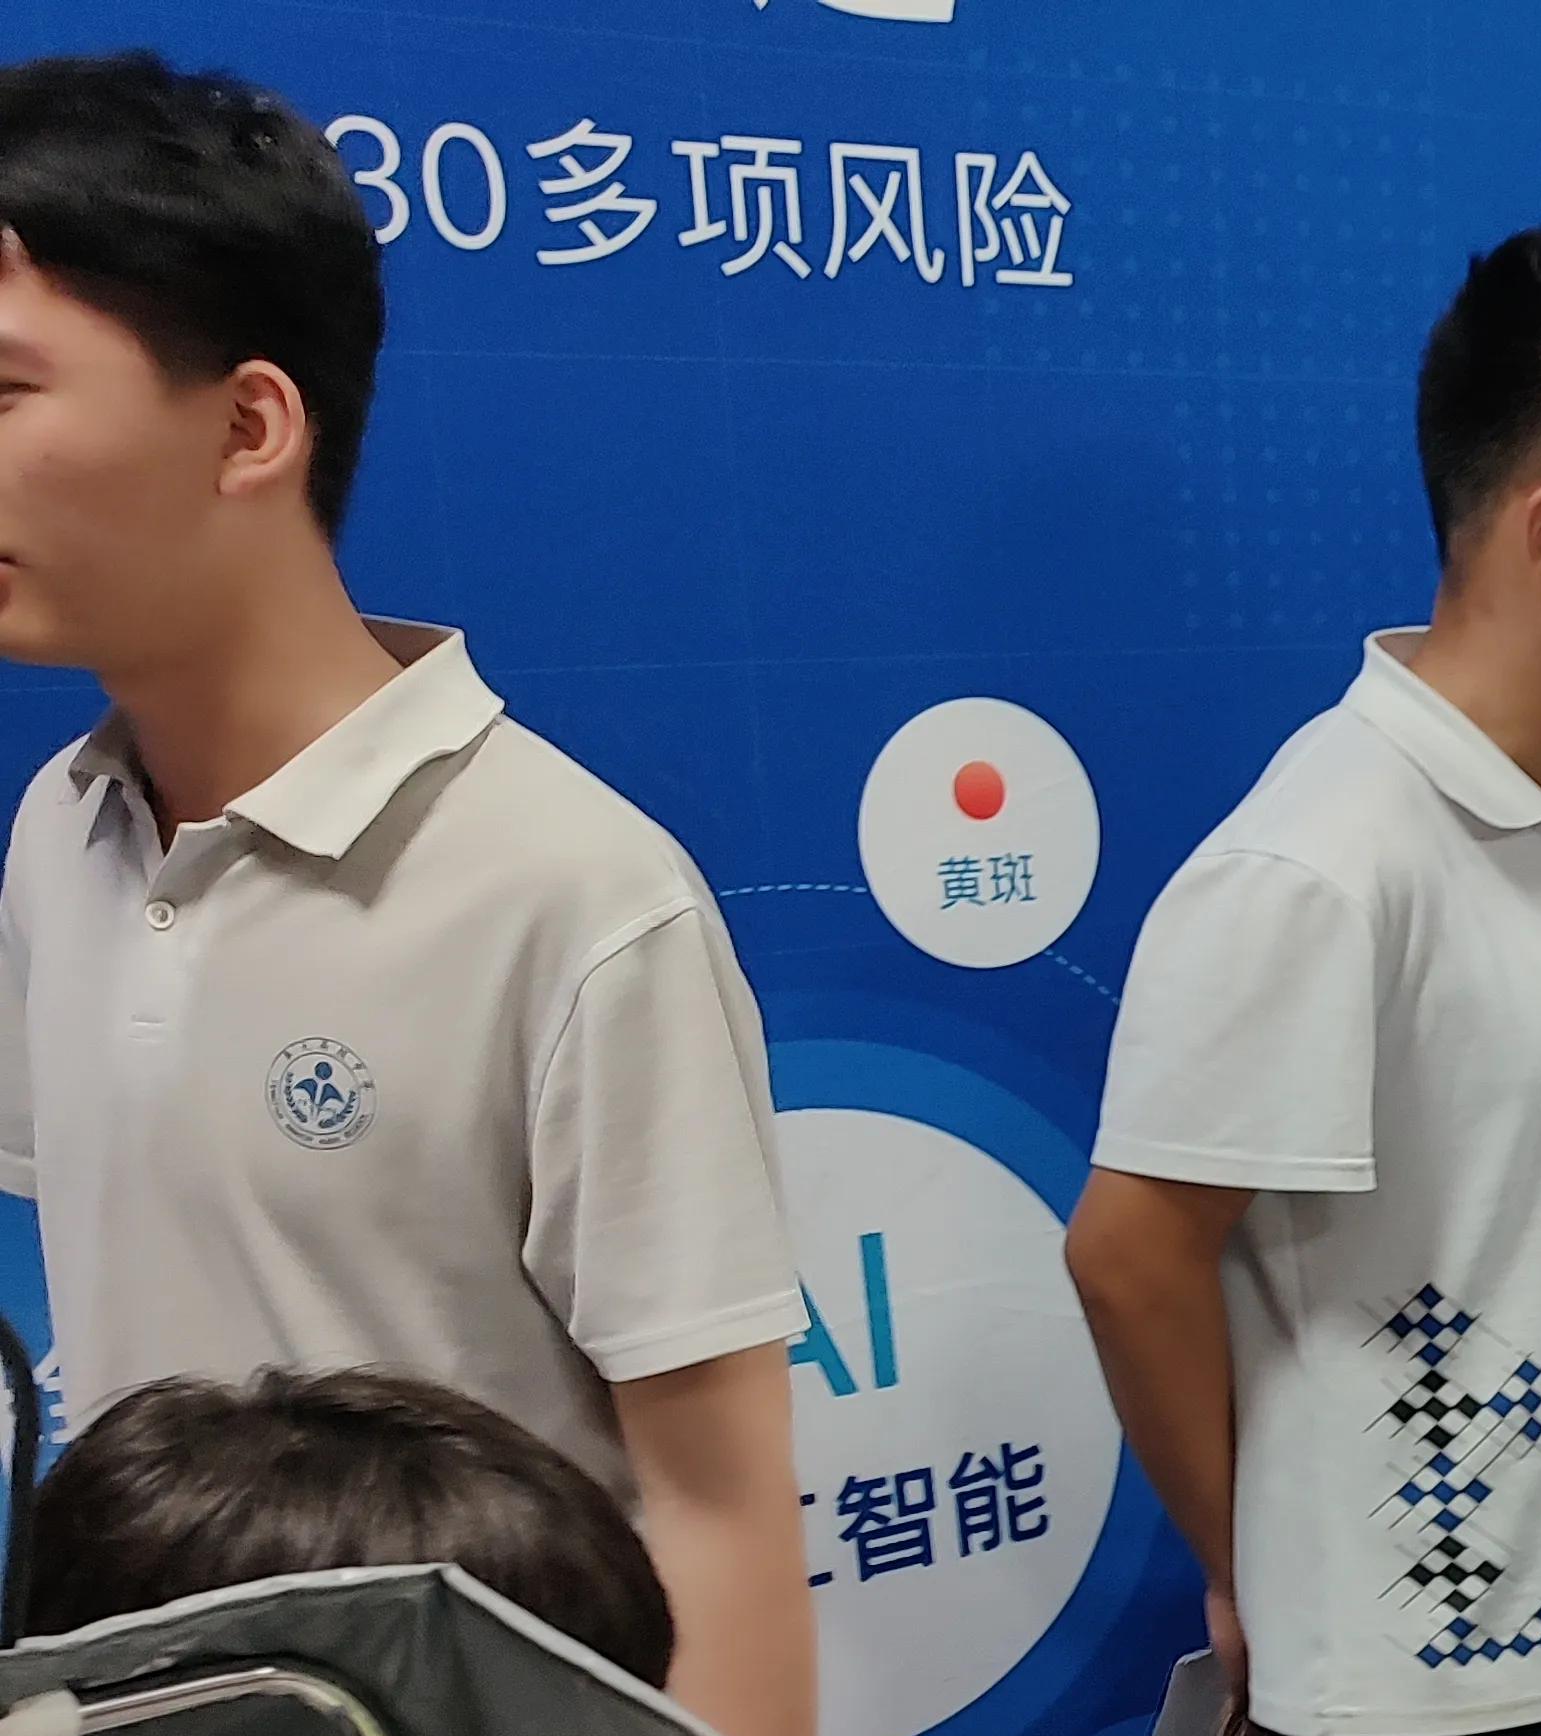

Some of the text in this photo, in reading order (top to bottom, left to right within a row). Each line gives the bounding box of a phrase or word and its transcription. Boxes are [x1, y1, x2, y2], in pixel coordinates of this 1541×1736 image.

[322, 113, 1074, 288] 30多项风险
[936, 852, 1037, 910] 黄斑
